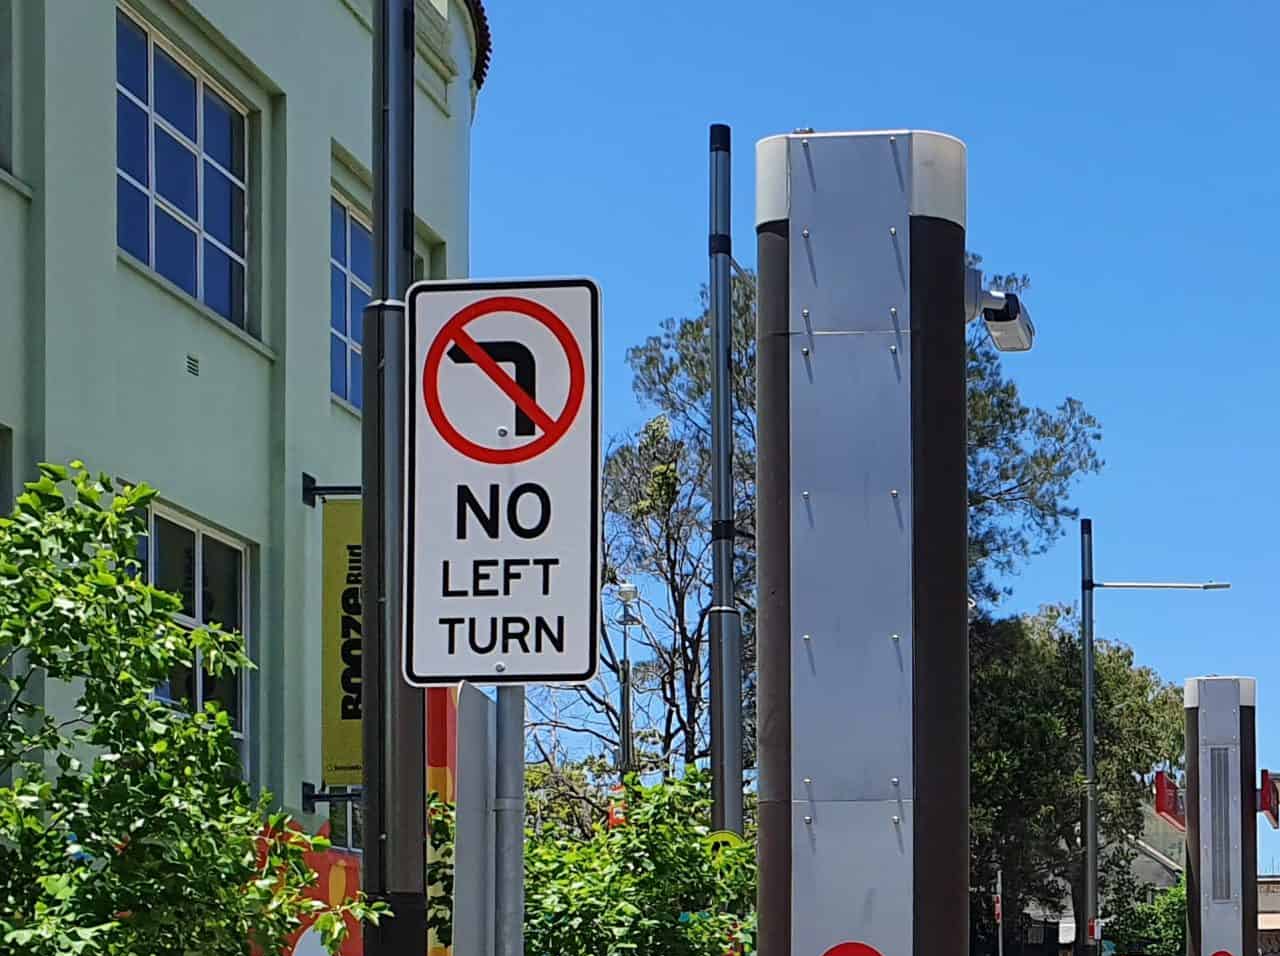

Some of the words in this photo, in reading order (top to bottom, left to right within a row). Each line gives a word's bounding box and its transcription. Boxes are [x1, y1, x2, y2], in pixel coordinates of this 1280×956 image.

[456, 482, 552, 540] NO
[442, 558, 560, 597] LEFT
[438, 615, 565, 655] TURN
